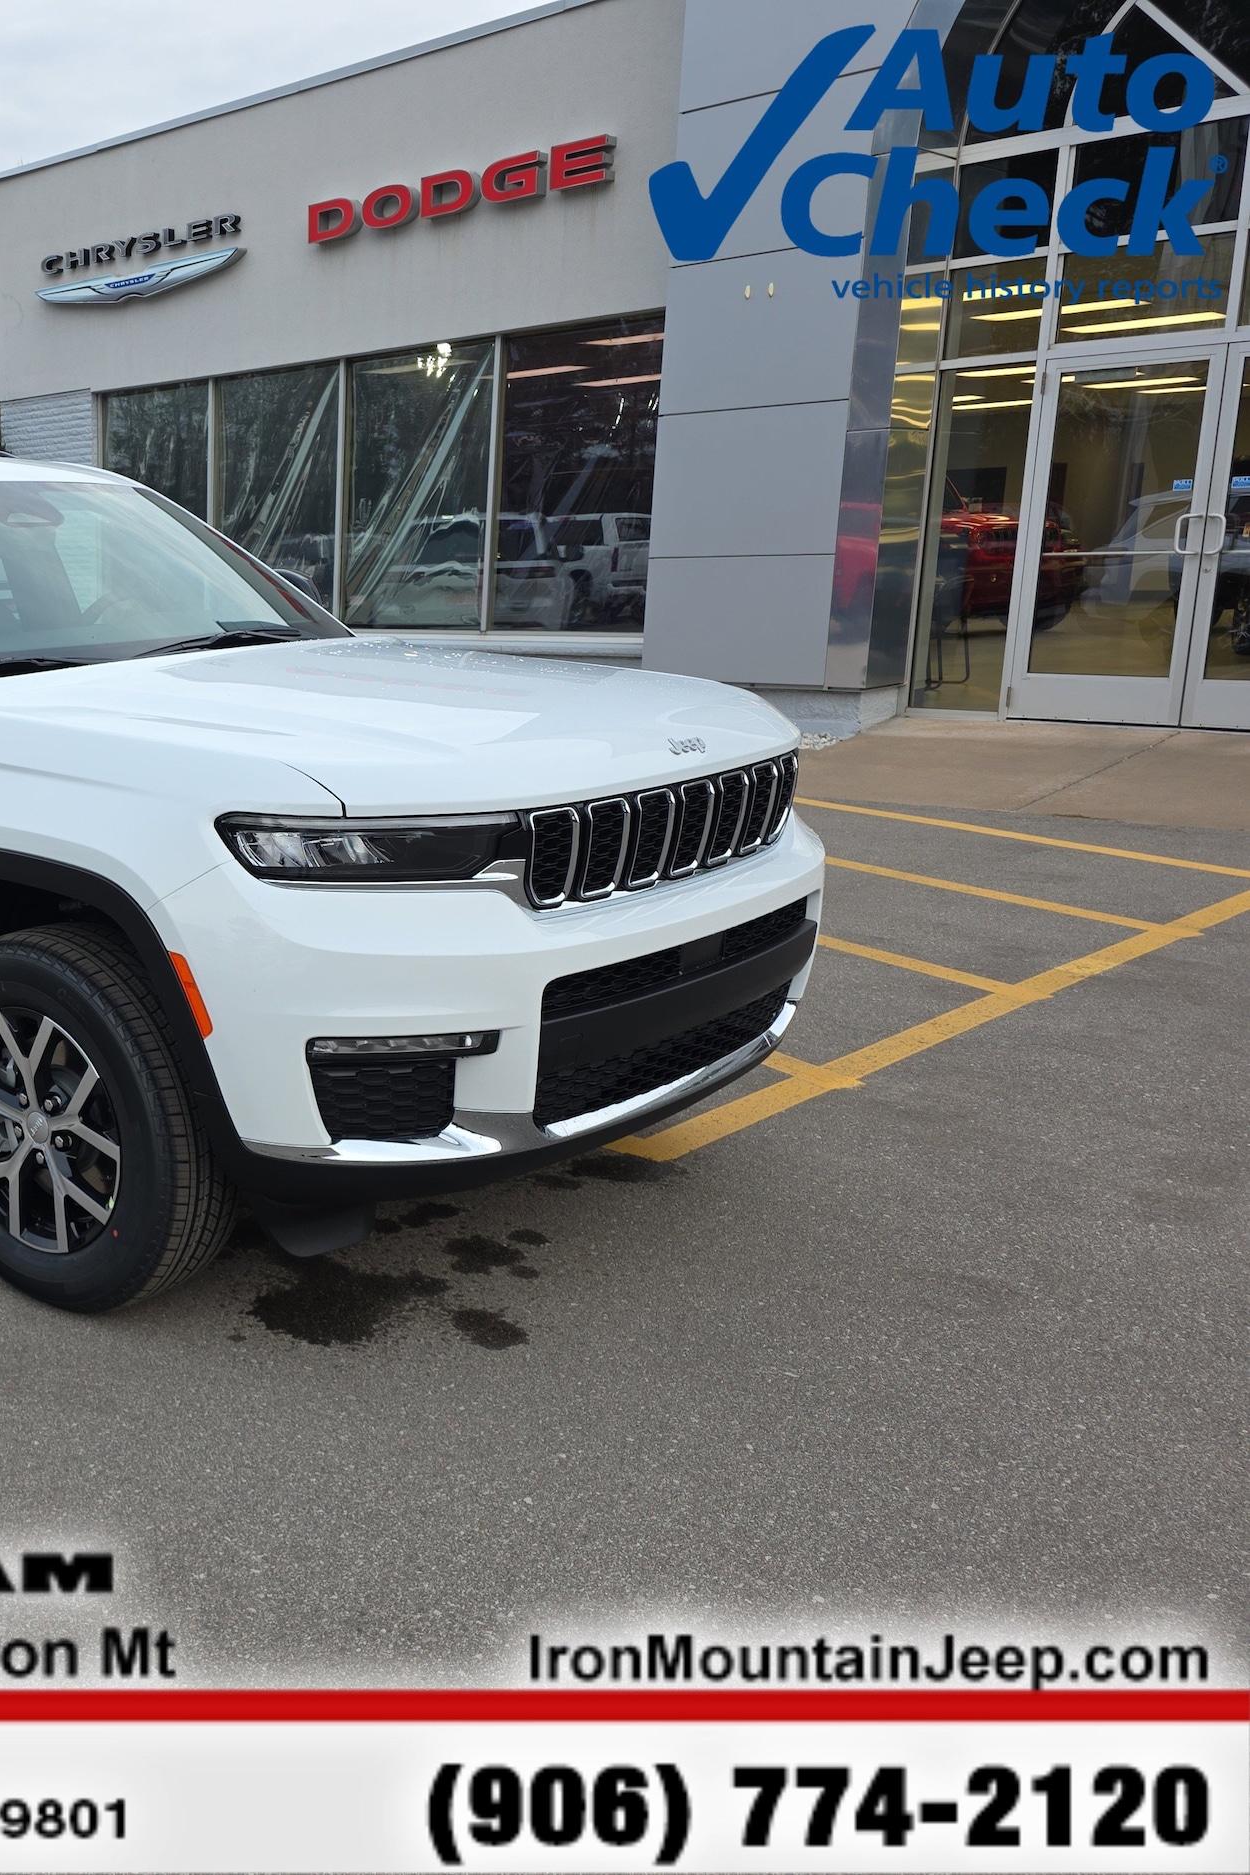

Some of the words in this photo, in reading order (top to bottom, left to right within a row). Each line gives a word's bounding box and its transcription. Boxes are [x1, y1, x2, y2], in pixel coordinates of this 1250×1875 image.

[308, 133, 617, 244] DODGE
[40, 212, 242, 276] CHRYSLER
[109, 276, 149, 288] CHRYSLER
[667, 736, 706, 756] Jeep
